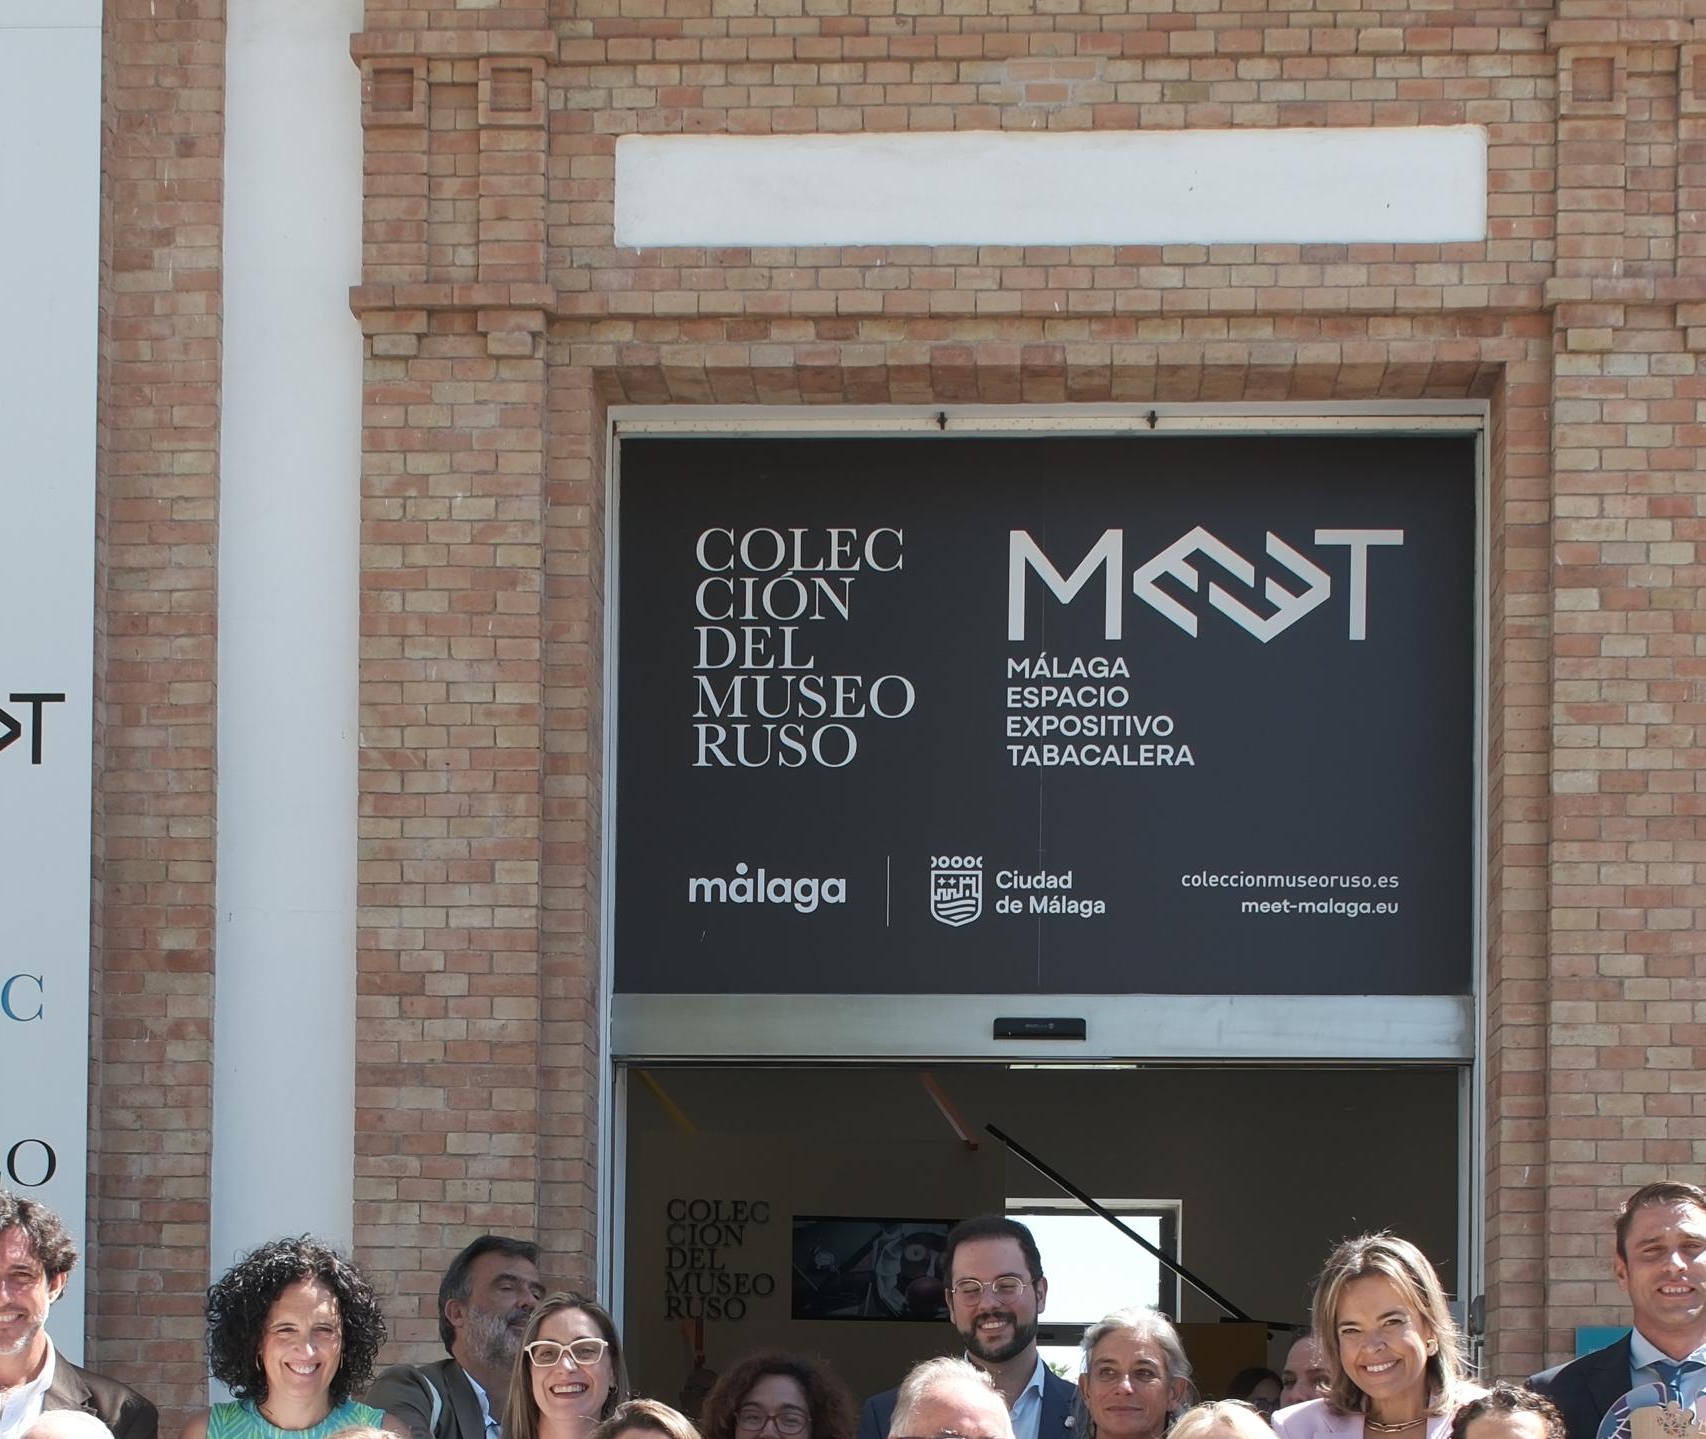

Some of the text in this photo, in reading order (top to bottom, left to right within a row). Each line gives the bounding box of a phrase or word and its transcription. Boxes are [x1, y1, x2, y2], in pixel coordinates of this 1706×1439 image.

[695, 527, 904, 573] COLEC
[695, 569, 856, 621] CIÓN
[693, 626, 815, 669] DEL
[1007, 652, 1130, 679] MÁLAGA
[693, 675, 916, 719] MUSEO
[1006, 686, 1130, 708] ESPACIO
[1006, 715, 1174, 737] EXPOSITIVO
[693, 724, 858, 768] RUSO
[1006, 744, 1195, 767] TABACALERA
[995, 869, 1073, 889] Ciudad
[1181, 871, 1399, 889] coleccionmuseoruso.es
[995, 895, 1106, 918] de Málaga
[1241, 898, 1399, 918] meet-malaga.eu
[667, 1198, 770, 1223] COLEC
[665, 1247, 726, 1270] DEL
[665, 1272, 775, 1296] MUSEO
[664, 1295, 747, 1320] RUSO
